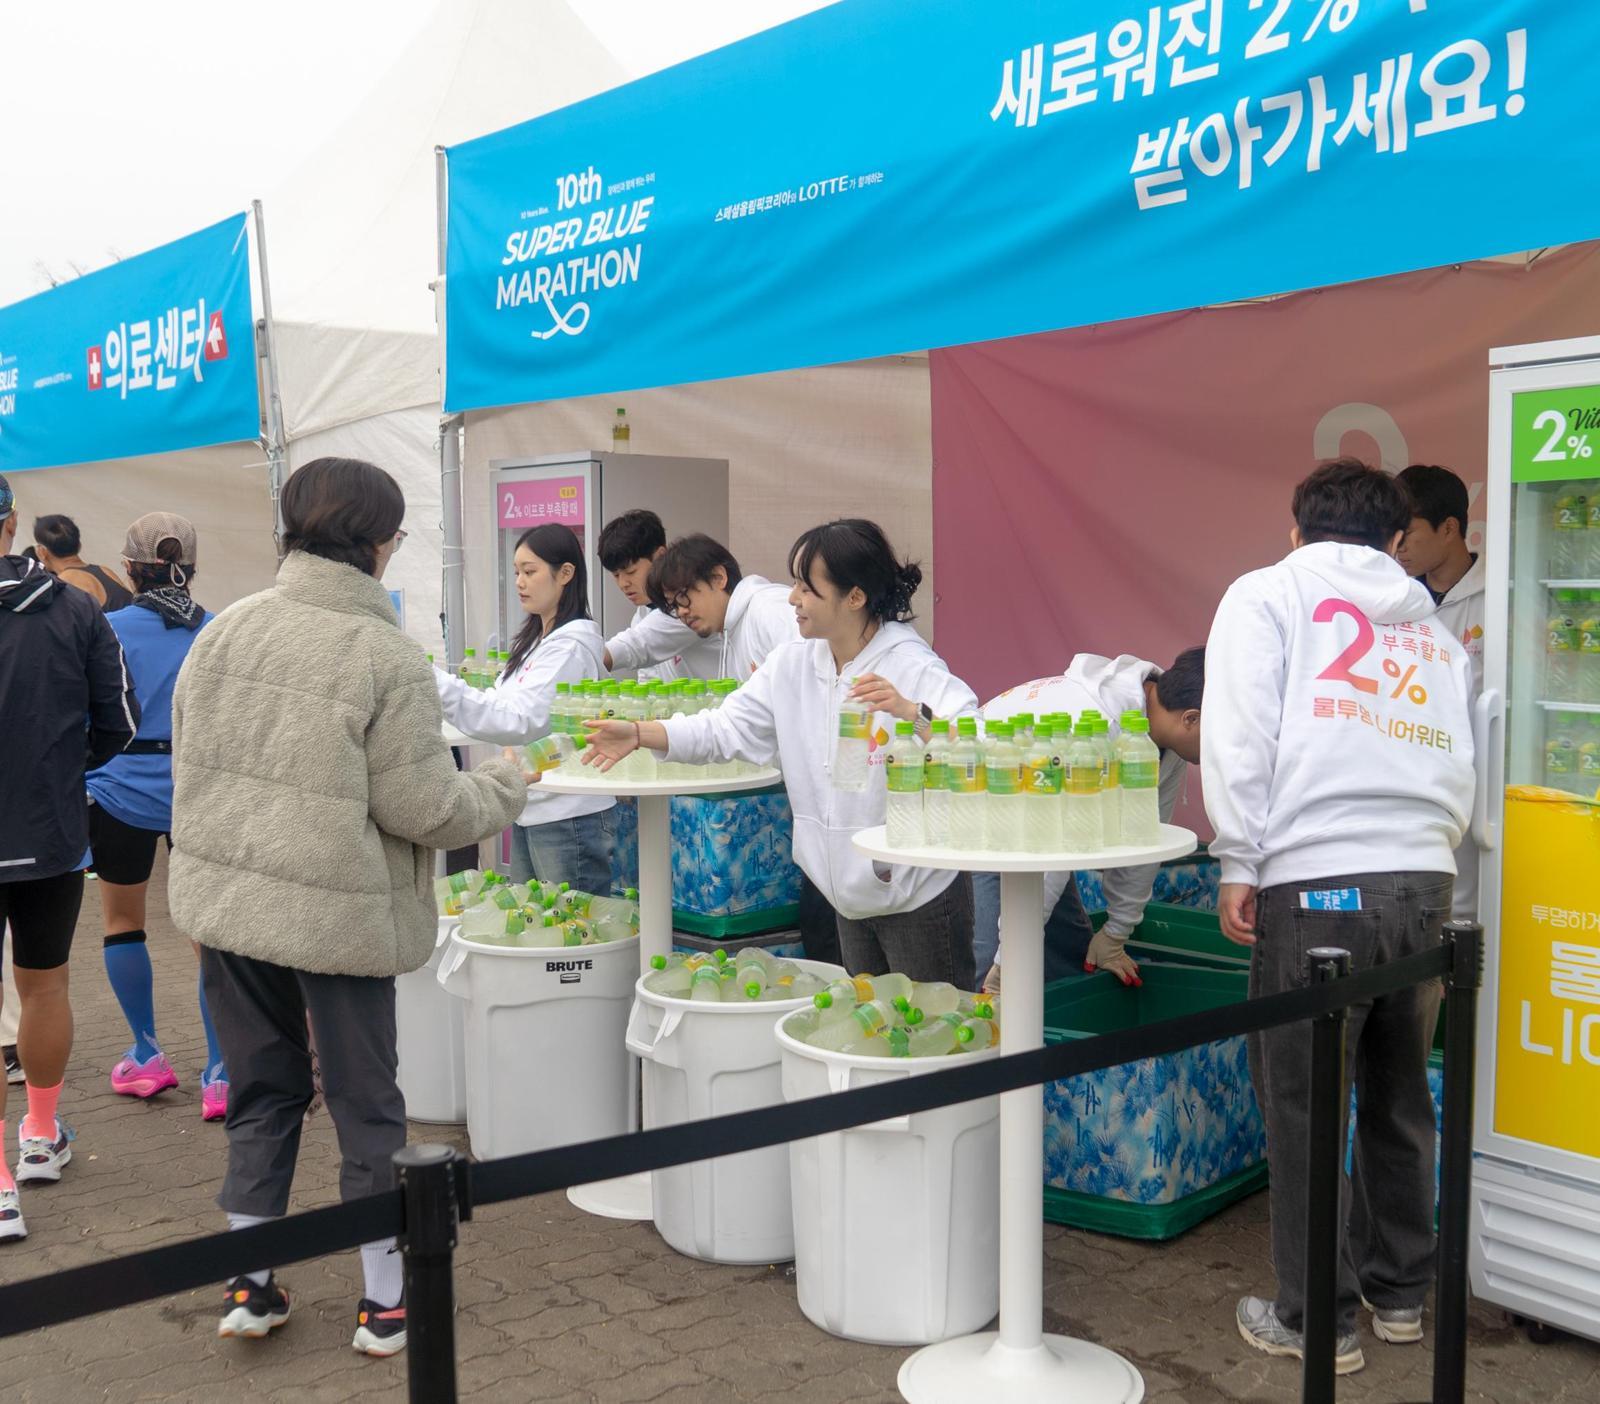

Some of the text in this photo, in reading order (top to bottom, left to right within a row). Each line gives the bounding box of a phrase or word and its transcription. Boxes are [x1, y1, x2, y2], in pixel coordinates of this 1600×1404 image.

[990, 0, 1223, 127] 새로워진
[1129, 28, 1528, 210] 받아가세요!
[556, 165, 602, 211] 10th
[502, 196, 655, 266] SUPER BLUE
[496, 243, 642, 311] MARATHON
[105, 297, 205, 400] 의료센터
[1532, 409, 1593, 462] 2%
[1312, 597, 1428, 706] 2%
[546, 959, 592, 972] BRUTE
